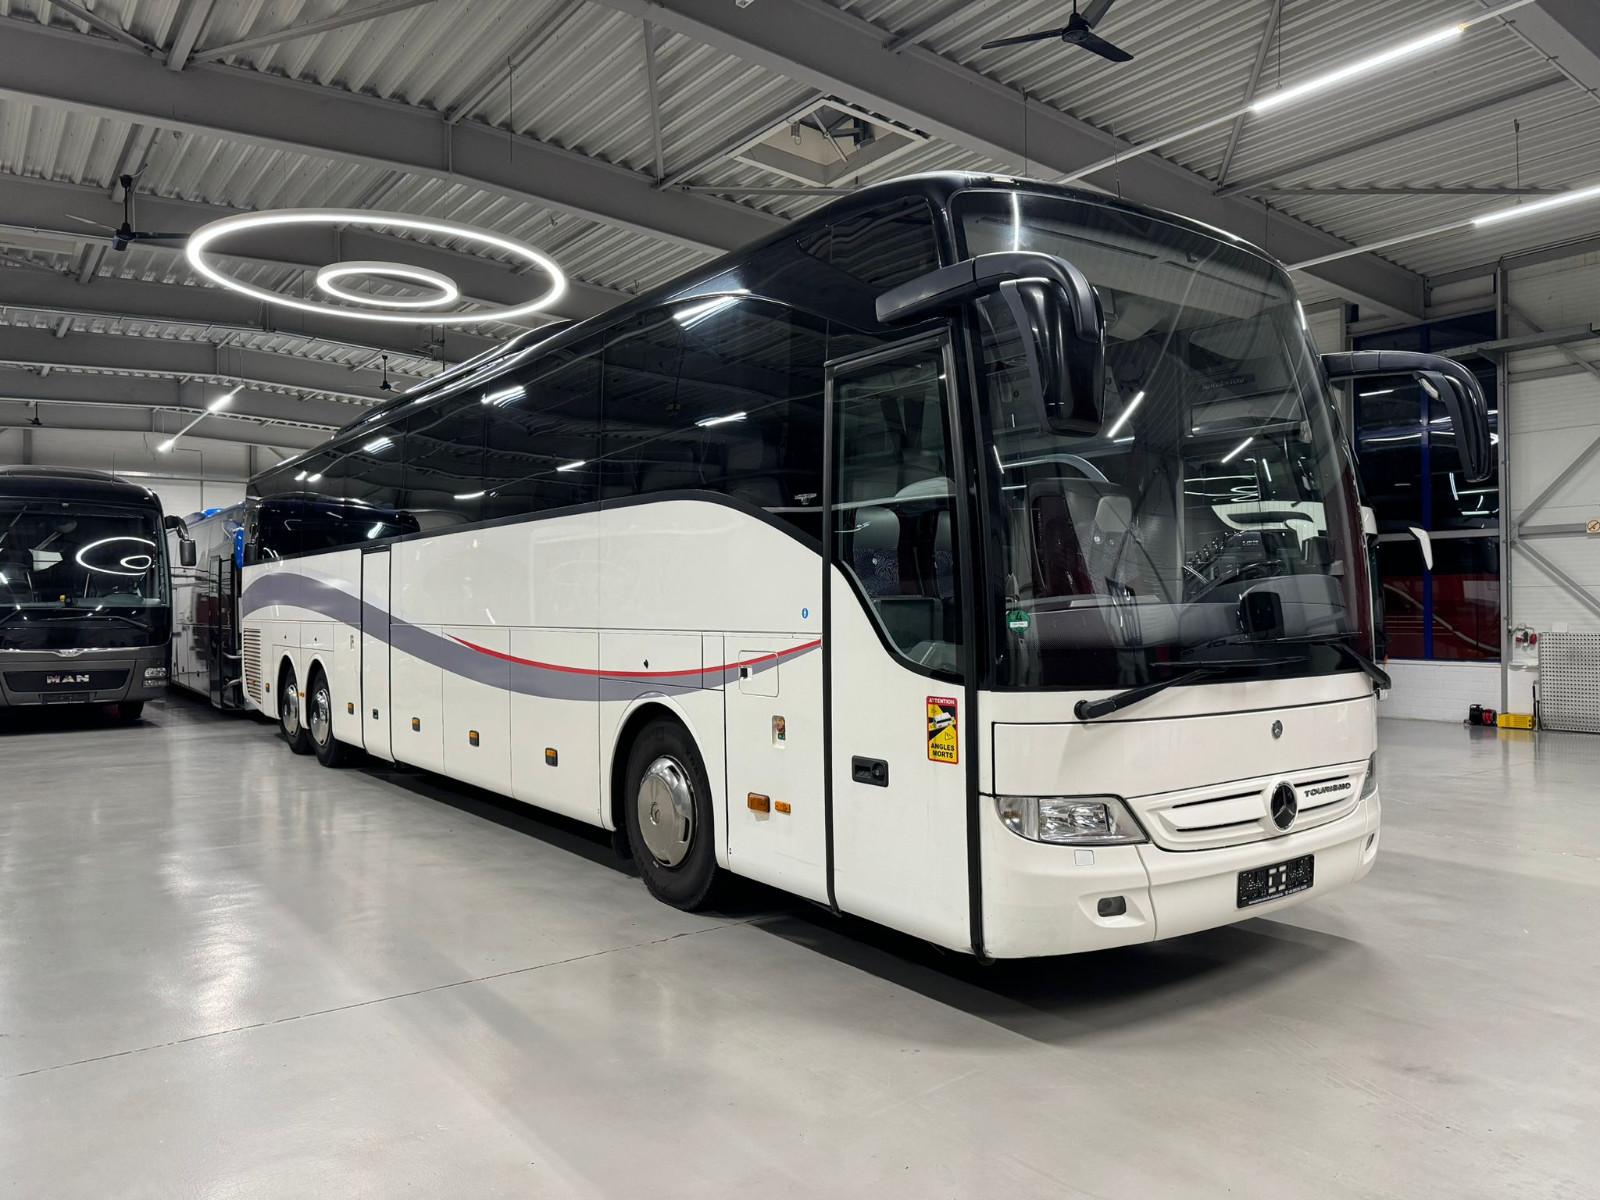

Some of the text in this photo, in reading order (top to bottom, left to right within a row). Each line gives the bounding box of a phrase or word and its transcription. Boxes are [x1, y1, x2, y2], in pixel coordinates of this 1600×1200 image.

[47, 674, 90, 684] MAN
[931, 743, 955, 751] ANGLES
[932, 750, 954, 758] MORTS
[1304, 782, 1352, 798] TOURISMO
